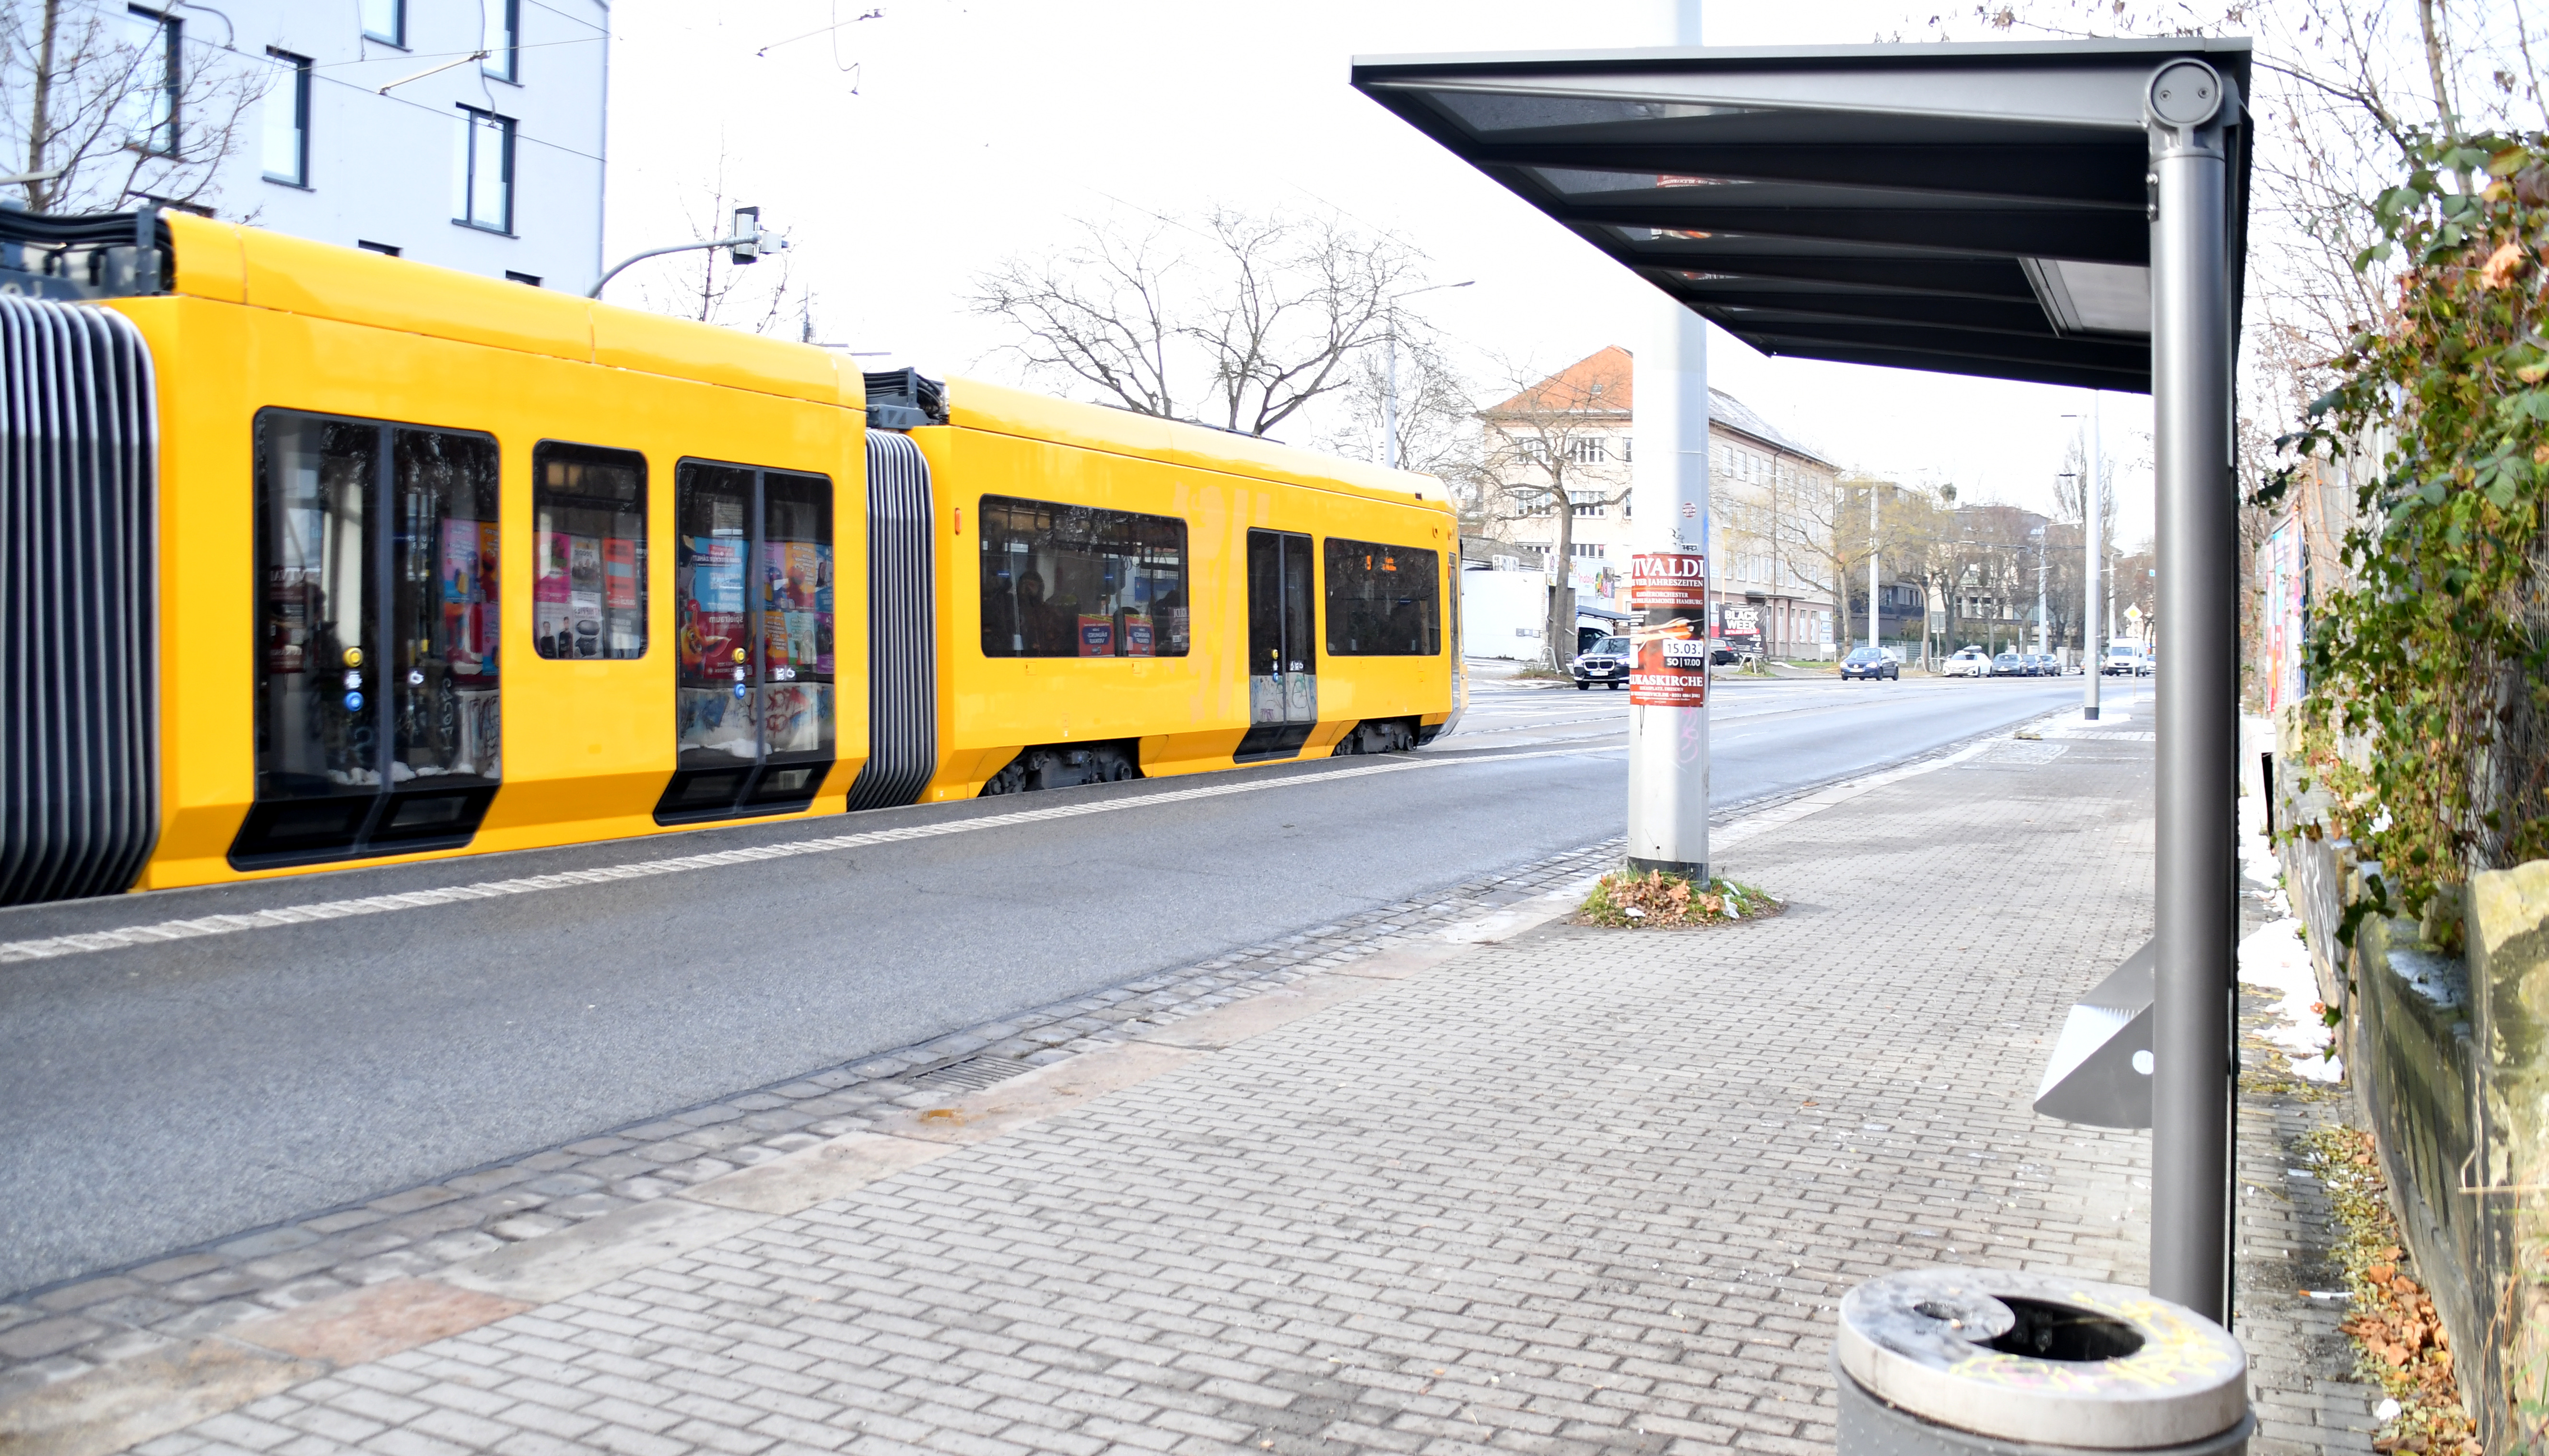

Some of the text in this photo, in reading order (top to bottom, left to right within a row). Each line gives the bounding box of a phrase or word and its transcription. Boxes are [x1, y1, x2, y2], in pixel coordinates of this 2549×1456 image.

[1648, 578, 1703, 587] JAHRESZEITEN
[1725, 610, 1759, 621] BLACK
[1727, 620, 1756, 630] WEEK
[1668, 644, 1700, 655] 15.03.
[1667, 658, 1701, 667] SO 17.00
